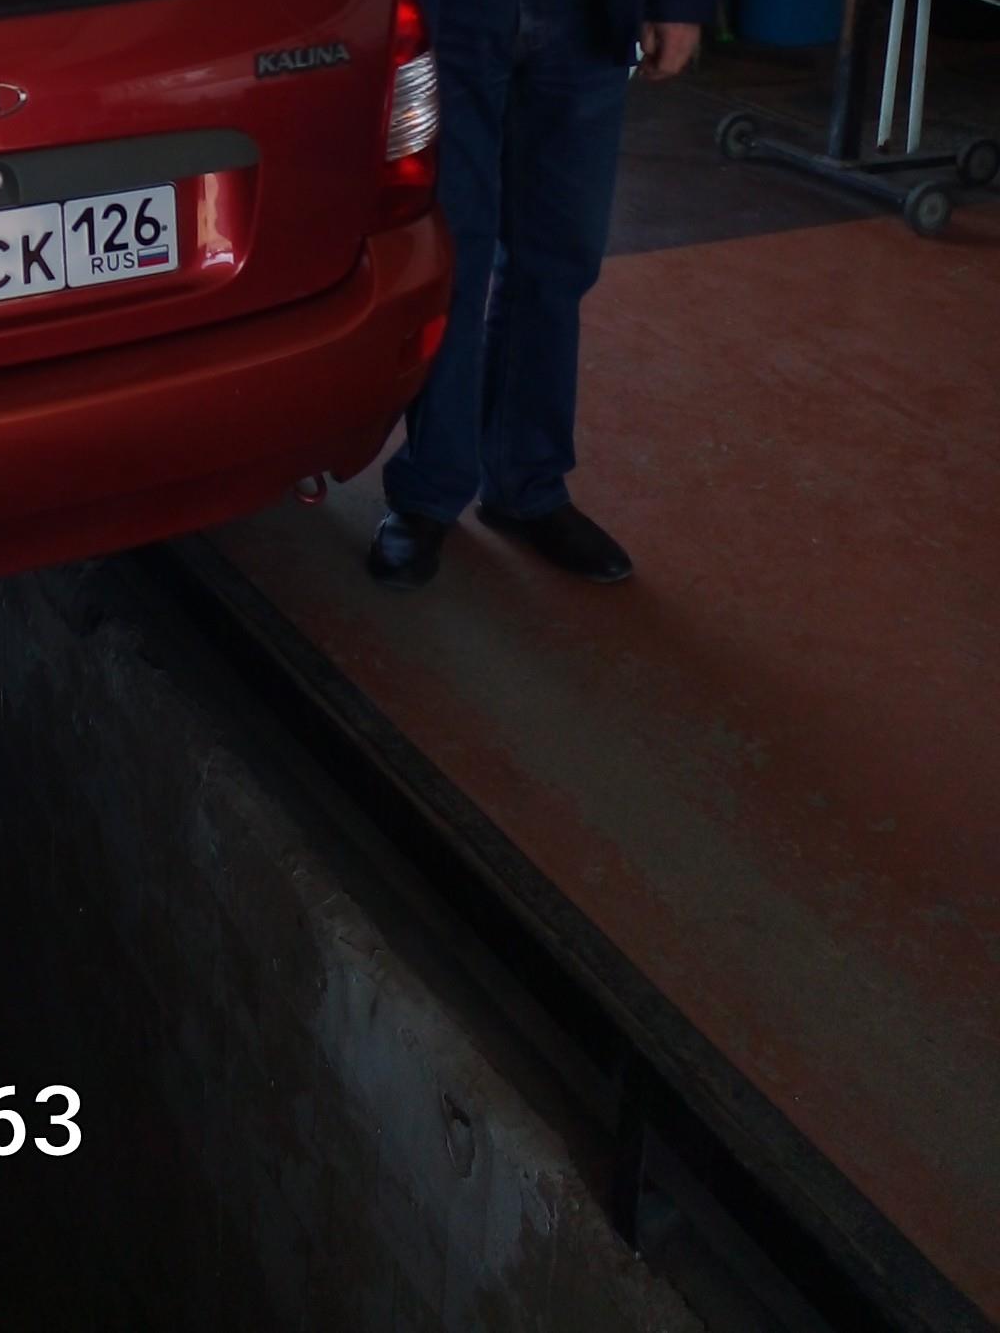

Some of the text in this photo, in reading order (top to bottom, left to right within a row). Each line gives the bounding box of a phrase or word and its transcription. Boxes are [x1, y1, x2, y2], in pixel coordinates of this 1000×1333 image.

[257, 43, 351, 78] KALINA
[71, 198, 161, 256] 126
[91, 252, 136, 275] RUS
